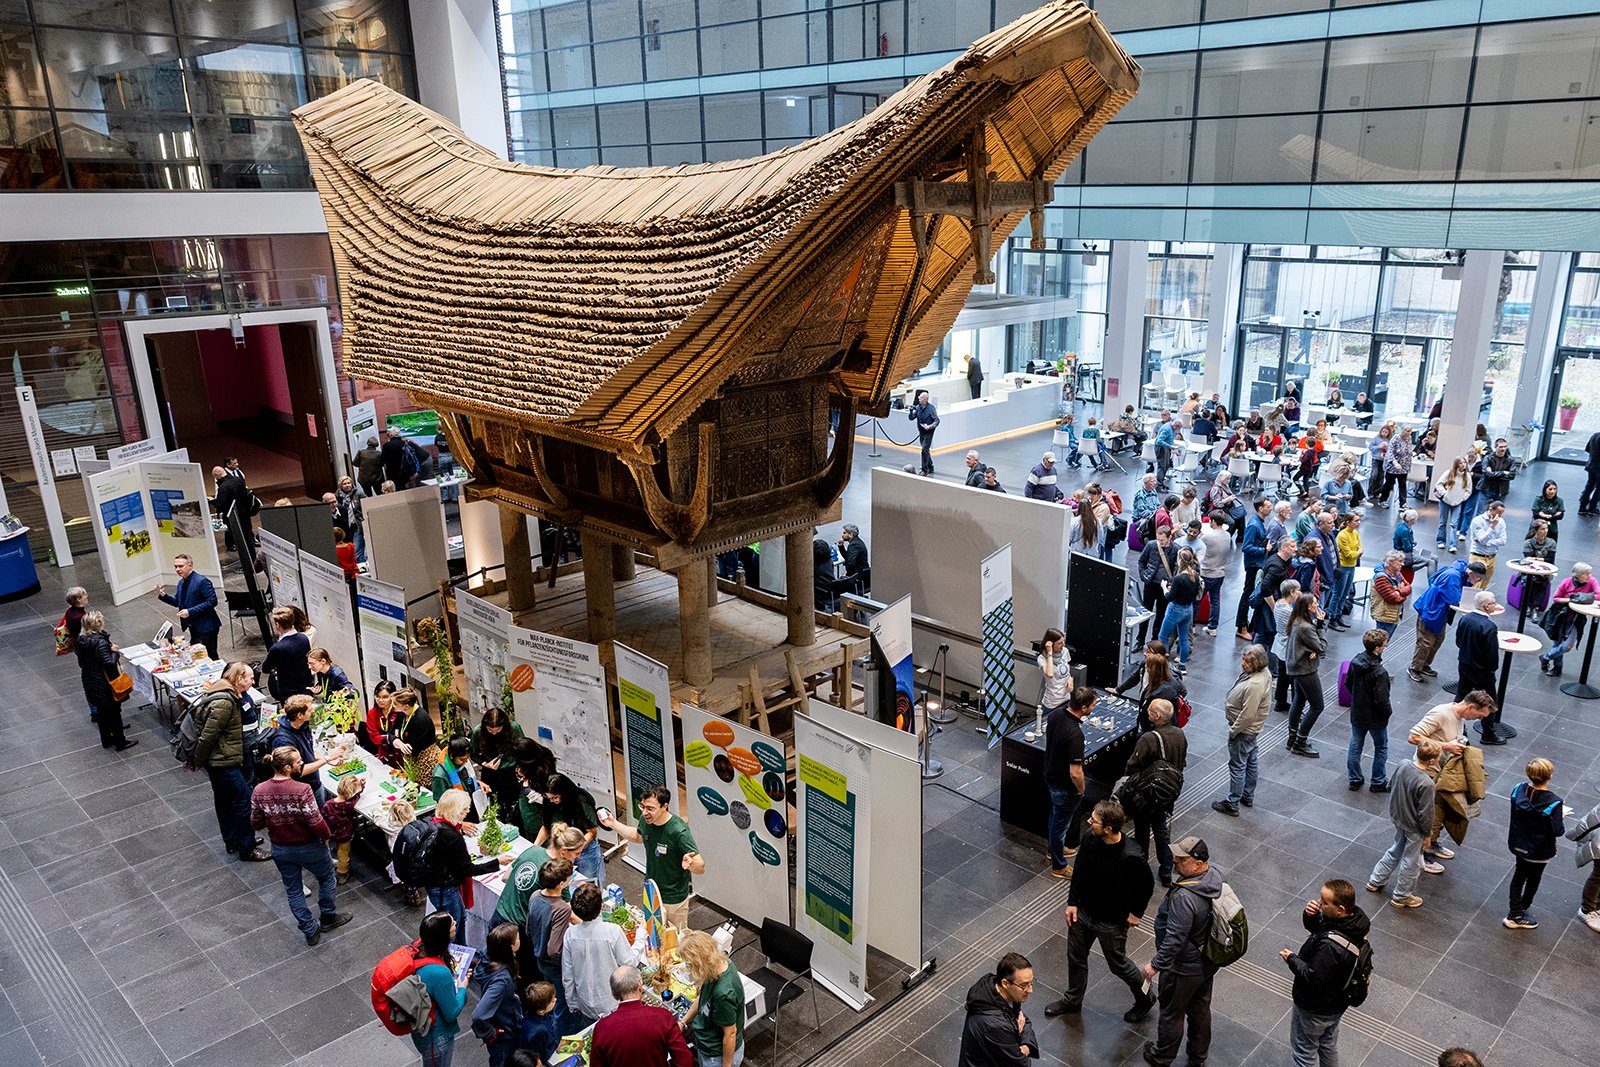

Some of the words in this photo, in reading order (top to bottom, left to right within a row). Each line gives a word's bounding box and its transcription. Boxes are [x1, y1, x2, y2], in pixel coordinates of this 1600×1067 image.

[22, 391, 30, 402] E
[517, 638, 526, 646] FÜR
[529, 634, 574, 650] MAX-PLANCK-INSTITUT
[1017, 765, 1029, 774] Fuels
